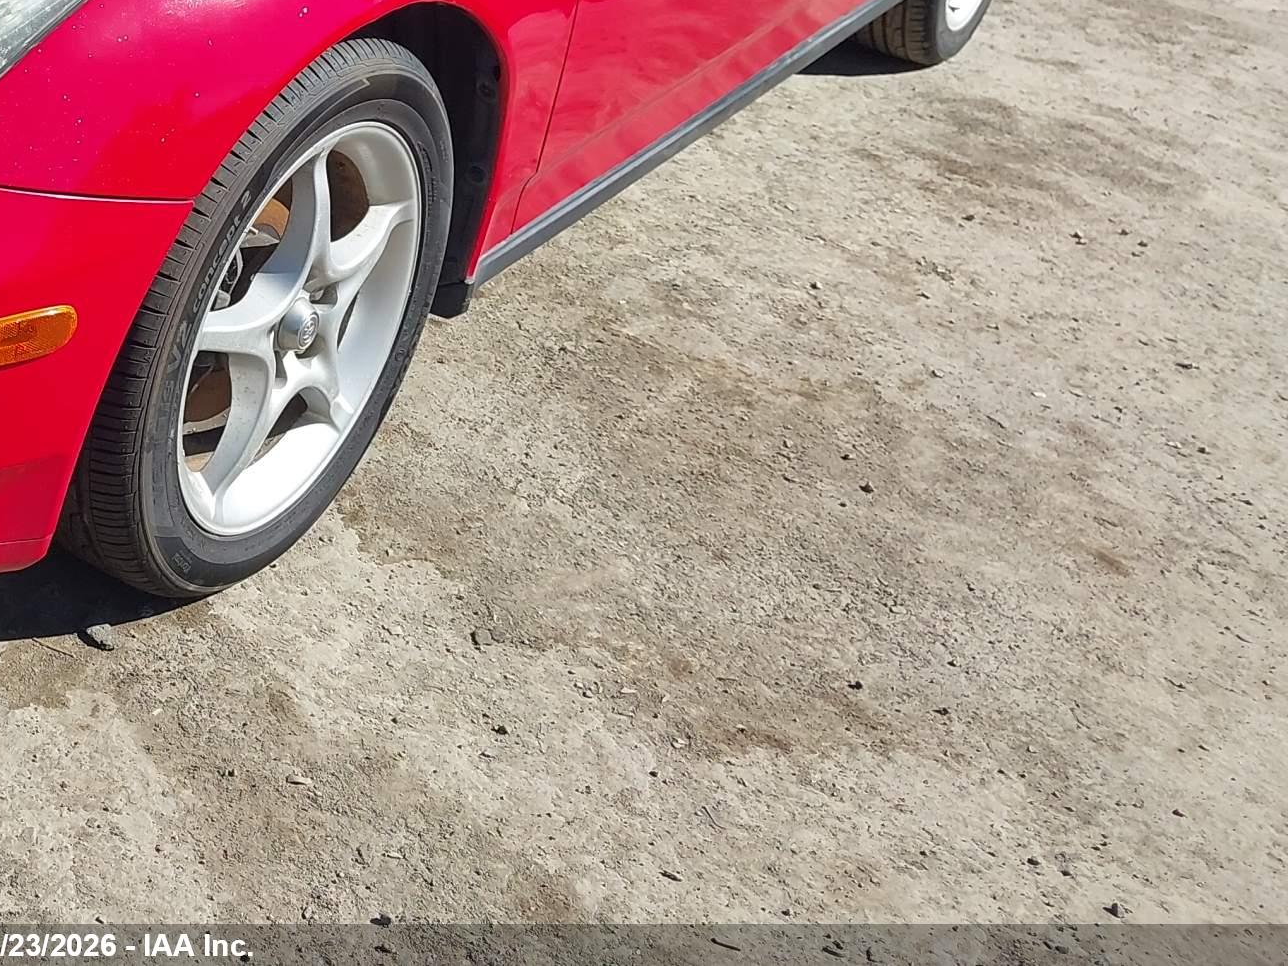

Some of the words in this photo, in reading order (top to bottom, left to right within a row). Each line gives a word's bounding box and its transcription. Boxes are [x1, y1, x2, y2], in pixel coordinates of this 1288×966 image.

[166, 319, 193, 373] V2
[192, 215, 242, 315] concept
[240, 188, 253, 210] 2
